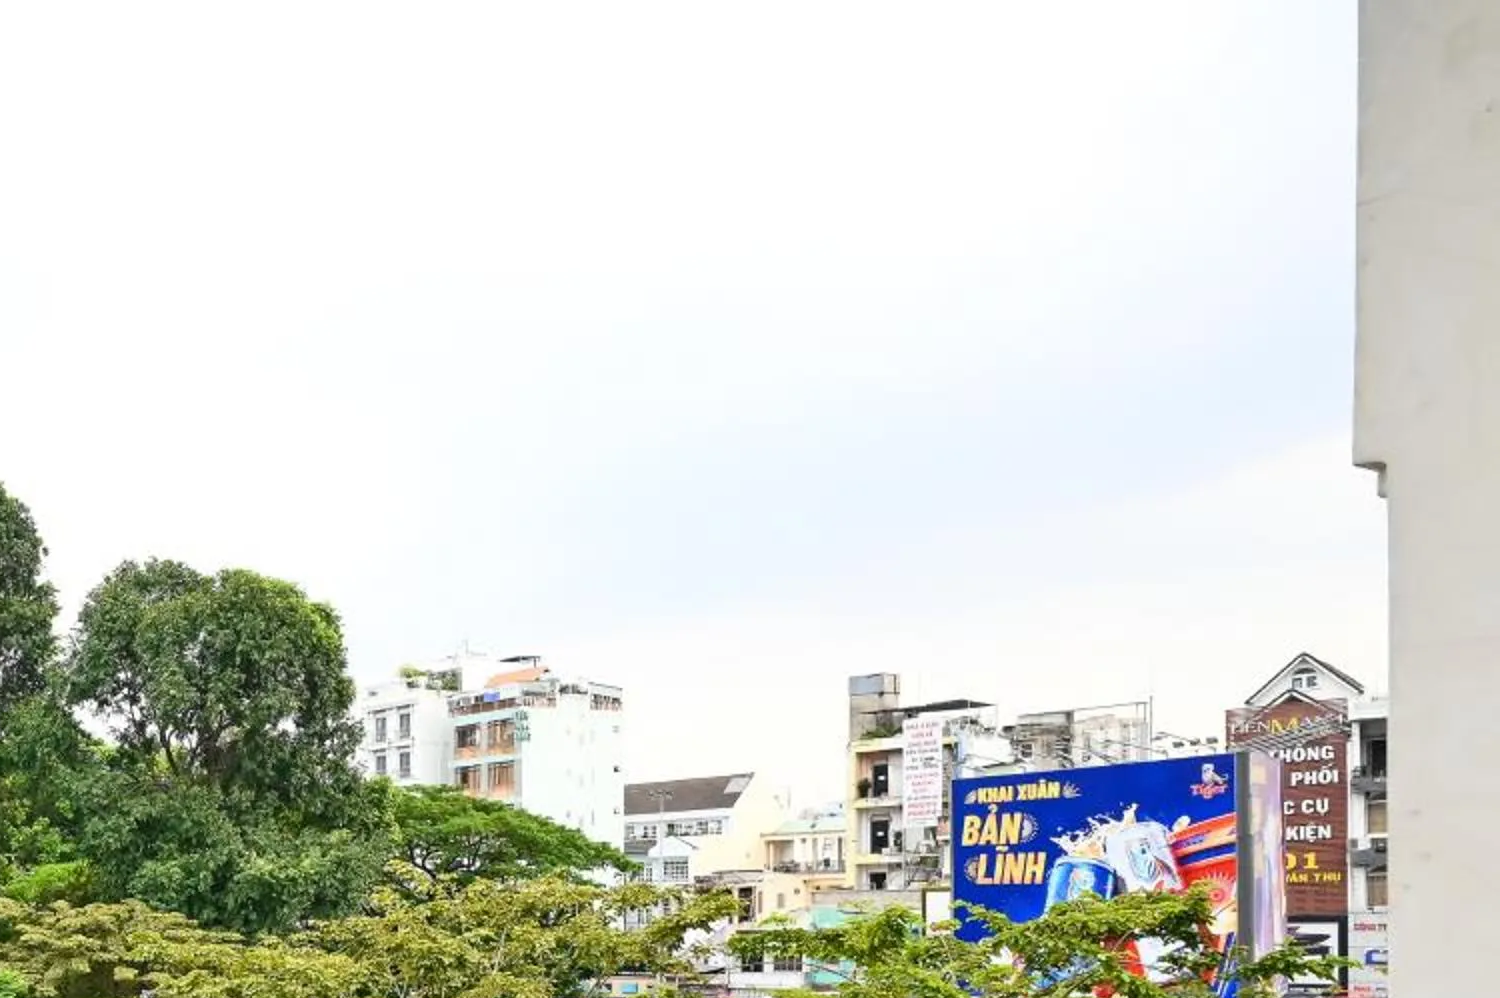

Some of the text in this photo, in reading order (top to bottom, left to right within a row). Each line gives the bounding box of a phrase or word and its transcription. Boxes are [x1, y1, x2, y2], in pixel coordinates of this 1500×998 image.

[977, 779, 1061, 804] KHAI XUÂN
[961, 803, 1022, 847] BẢN
[1285, 821, 1333, 844] KIỆN
